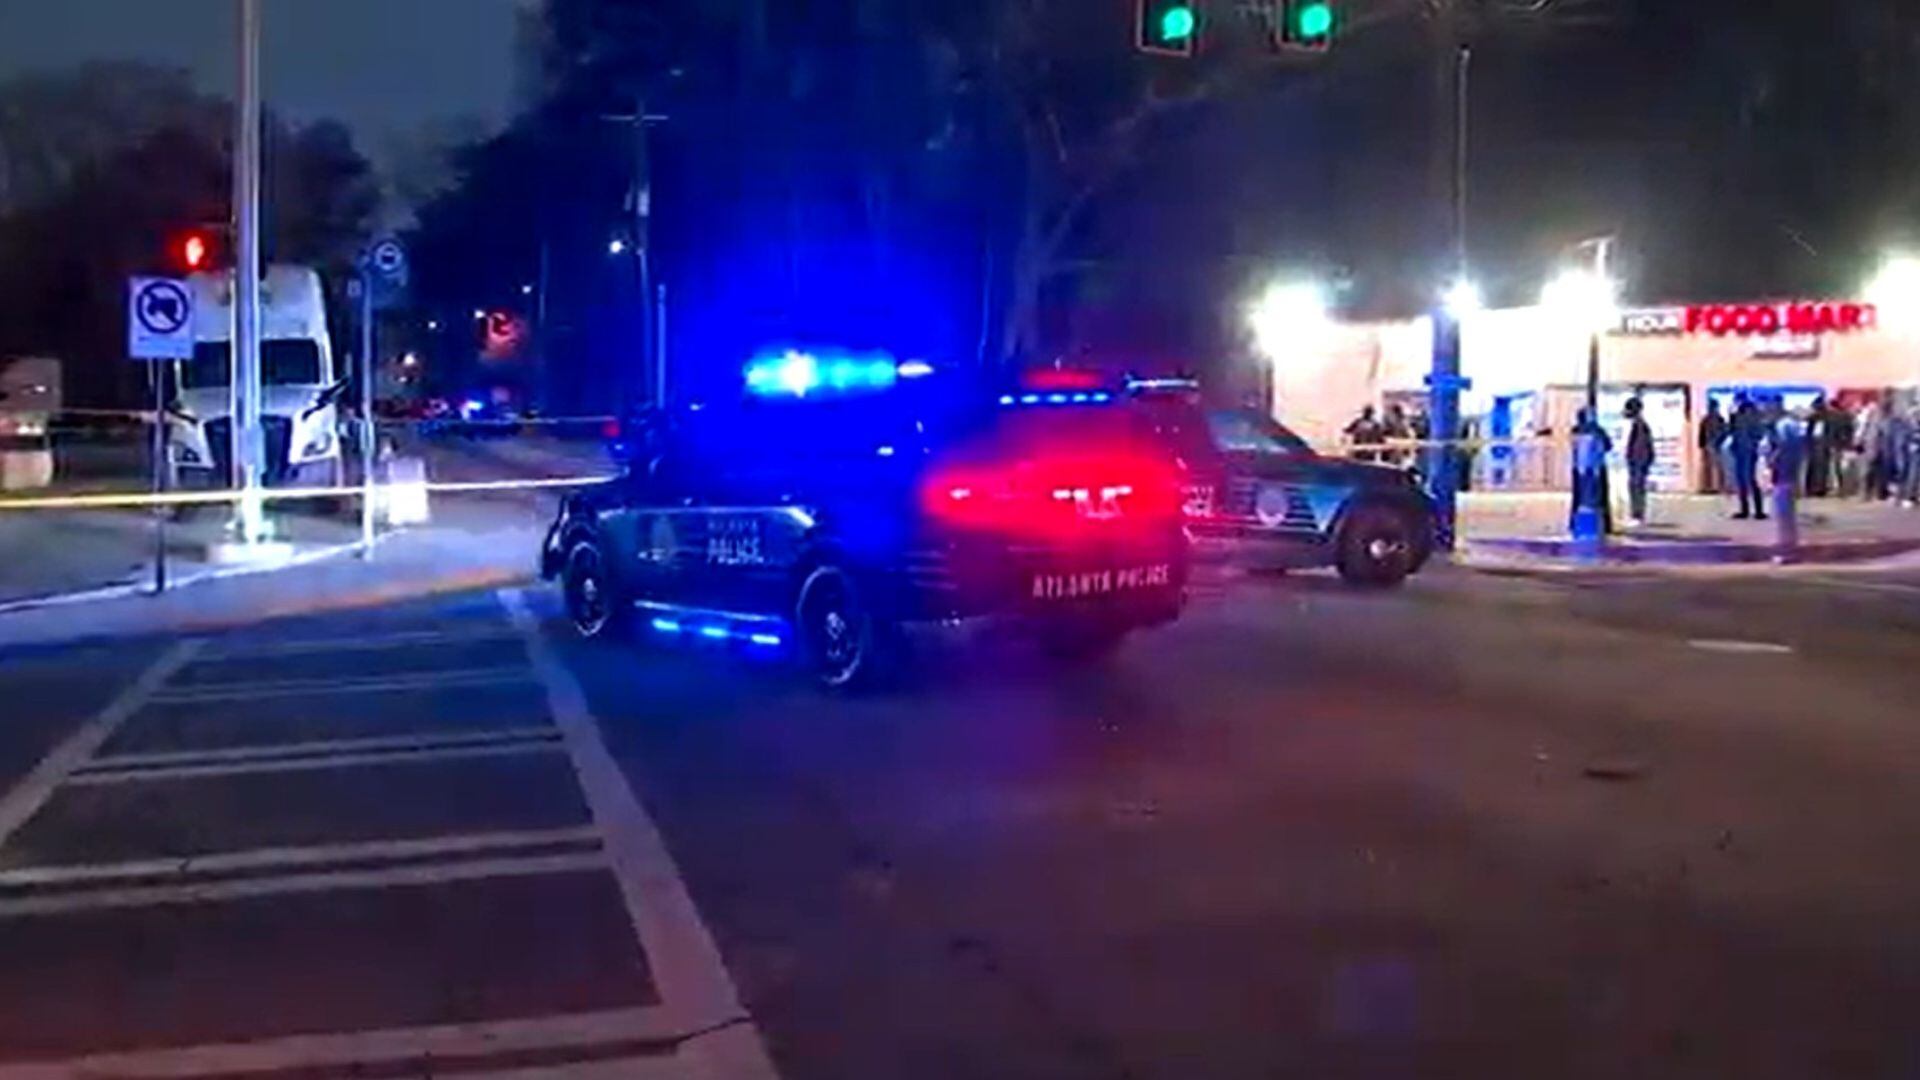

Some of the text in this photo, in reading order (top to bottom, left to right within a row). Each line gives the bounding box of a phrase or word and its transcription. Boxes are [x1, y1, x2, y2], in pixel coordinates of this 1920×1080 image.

[1685, 304, 1777, 336] FOOD
[1032, 562, 1169, 600] ATLANTA POLICE
